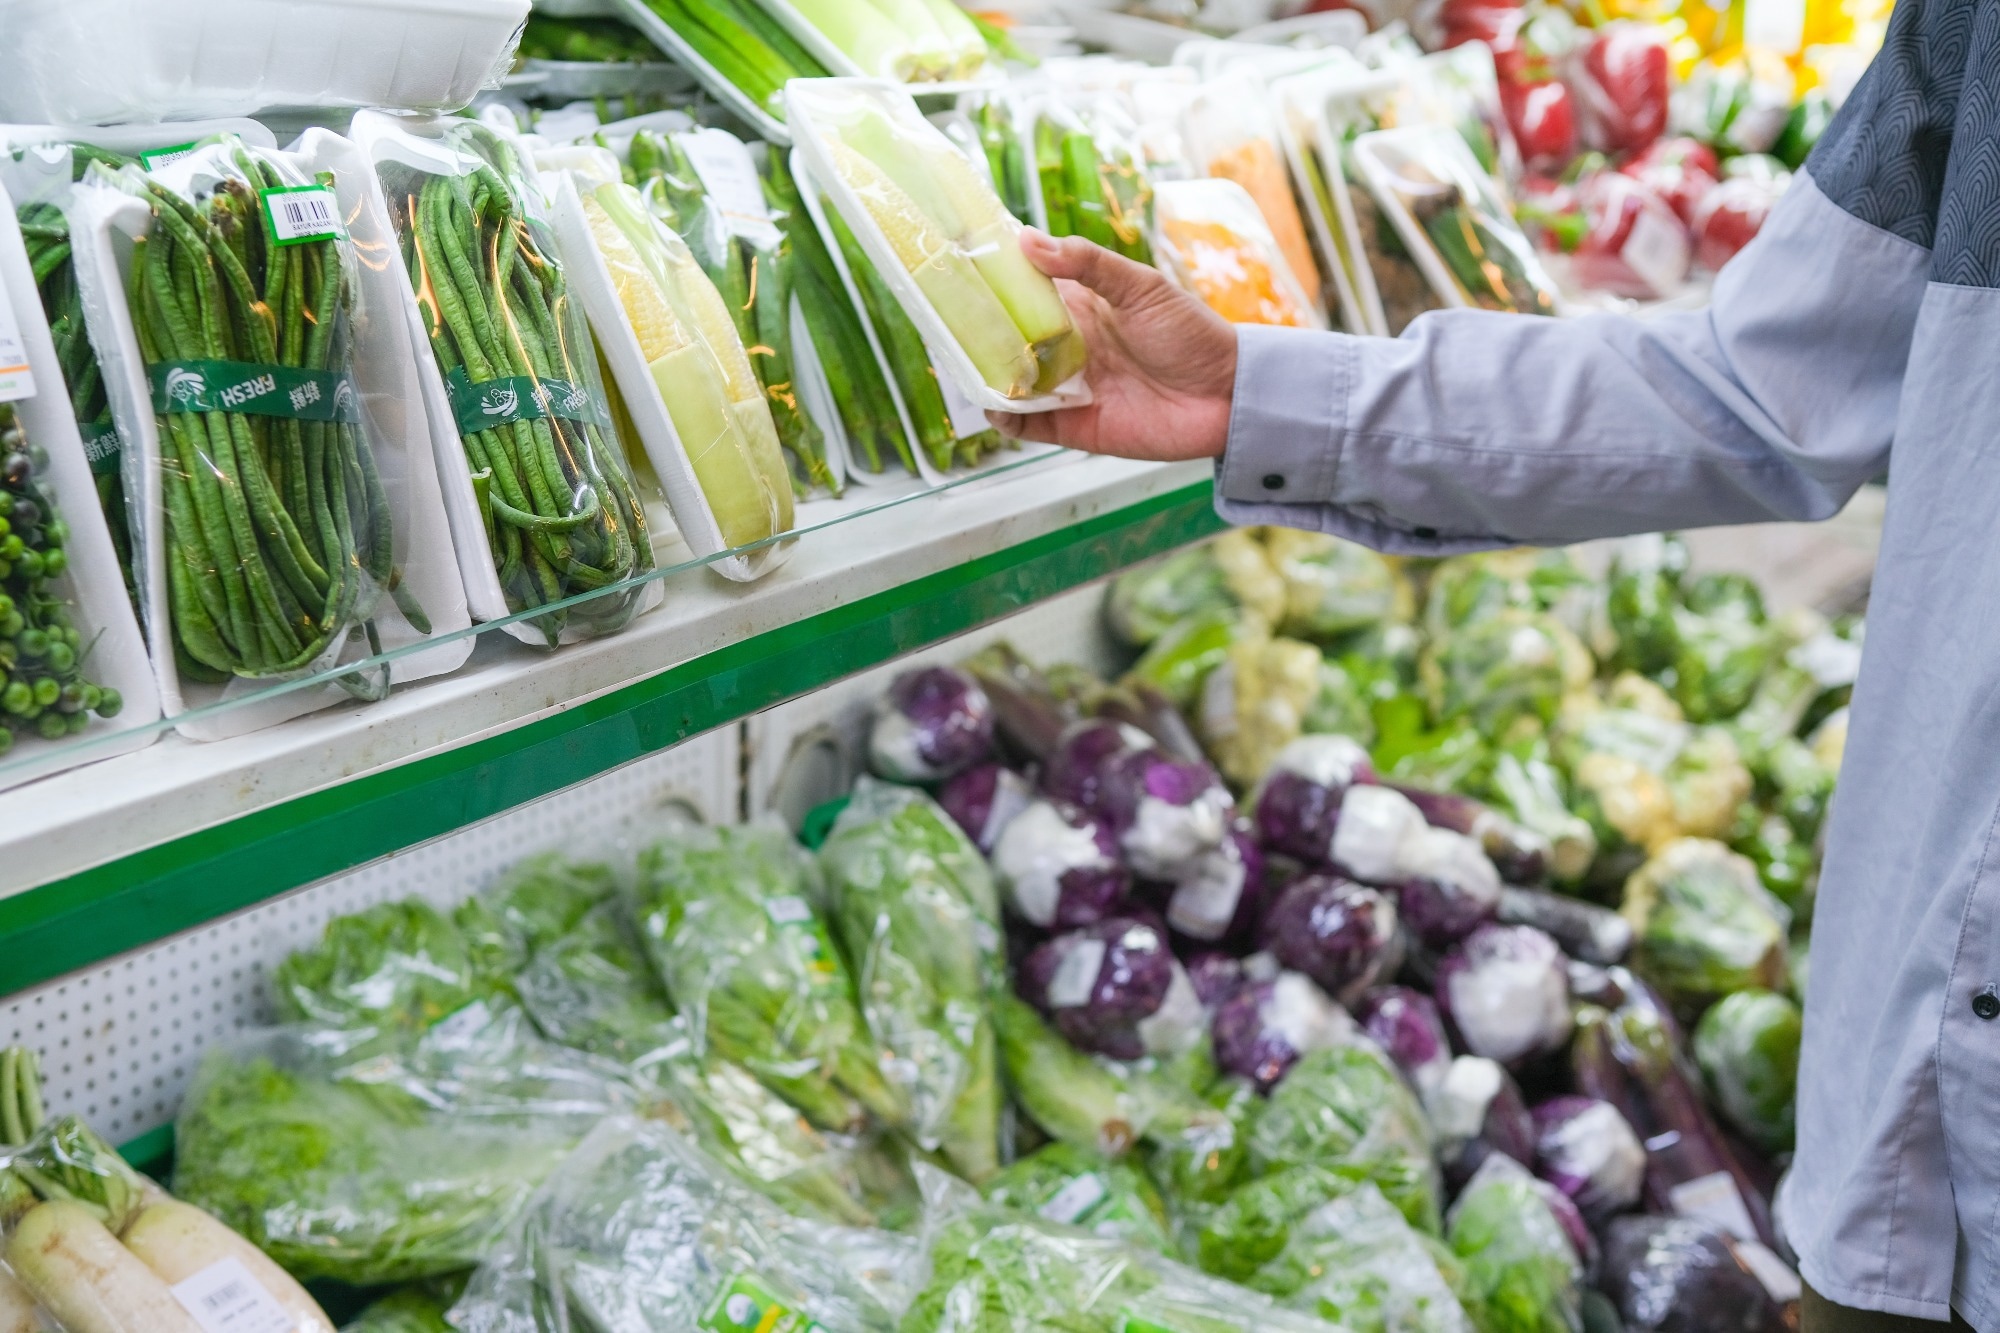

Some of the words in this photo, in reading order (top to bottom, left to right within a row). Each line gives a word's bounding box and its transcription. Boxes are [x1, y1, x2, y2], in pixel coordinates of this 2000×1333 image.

[220, 373, 276, 408] FRESH
[289, 380, 321, 411] 新鮮
[563, 388, 591, 412] FRESH
